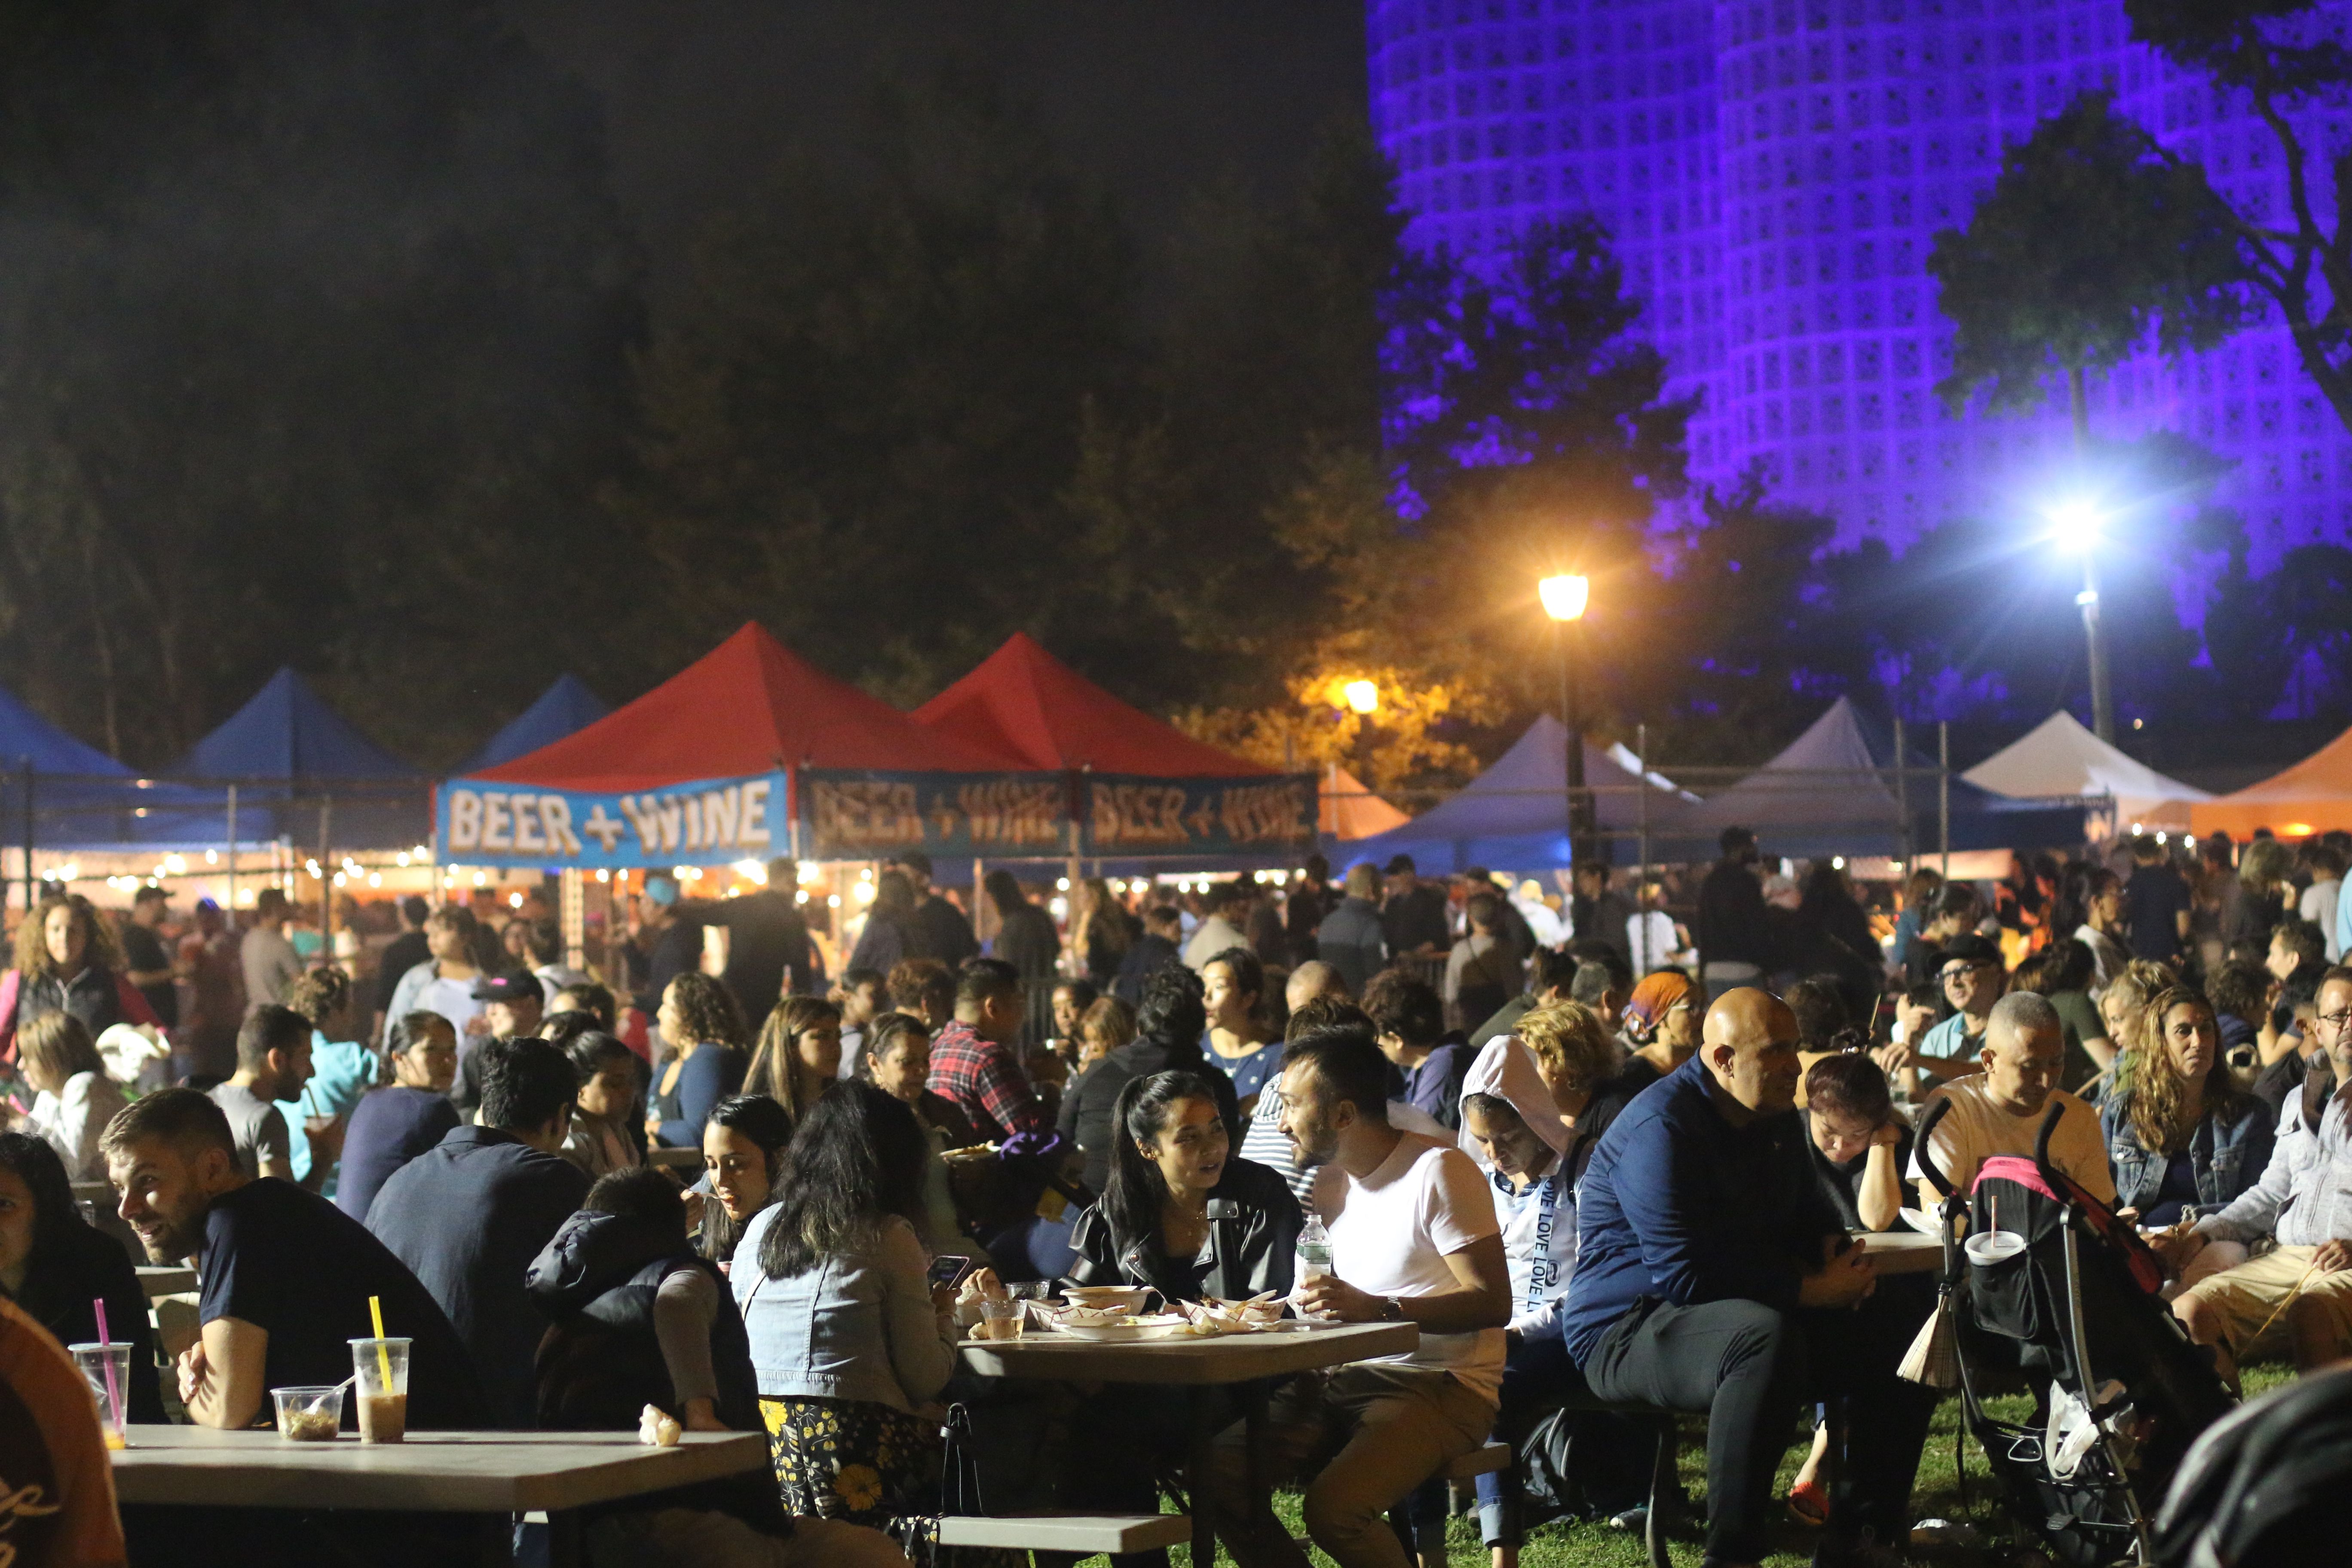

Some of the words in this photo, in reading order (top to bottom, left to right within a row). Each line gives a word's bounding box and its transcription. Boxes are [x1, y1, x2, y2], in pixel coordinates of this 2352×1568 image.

[449, 790, 582, 856] BEER
[585, 805, 625, 852] +
[620, 781, 772, 856] WINE
[1091, 783, 1191, 843] BEER
[1540, 1180, 1555, 1207] OVE
[1535, 1213, 1553, 1252] LOVE
[1529, 1257, 1547, 1295] LOVE
